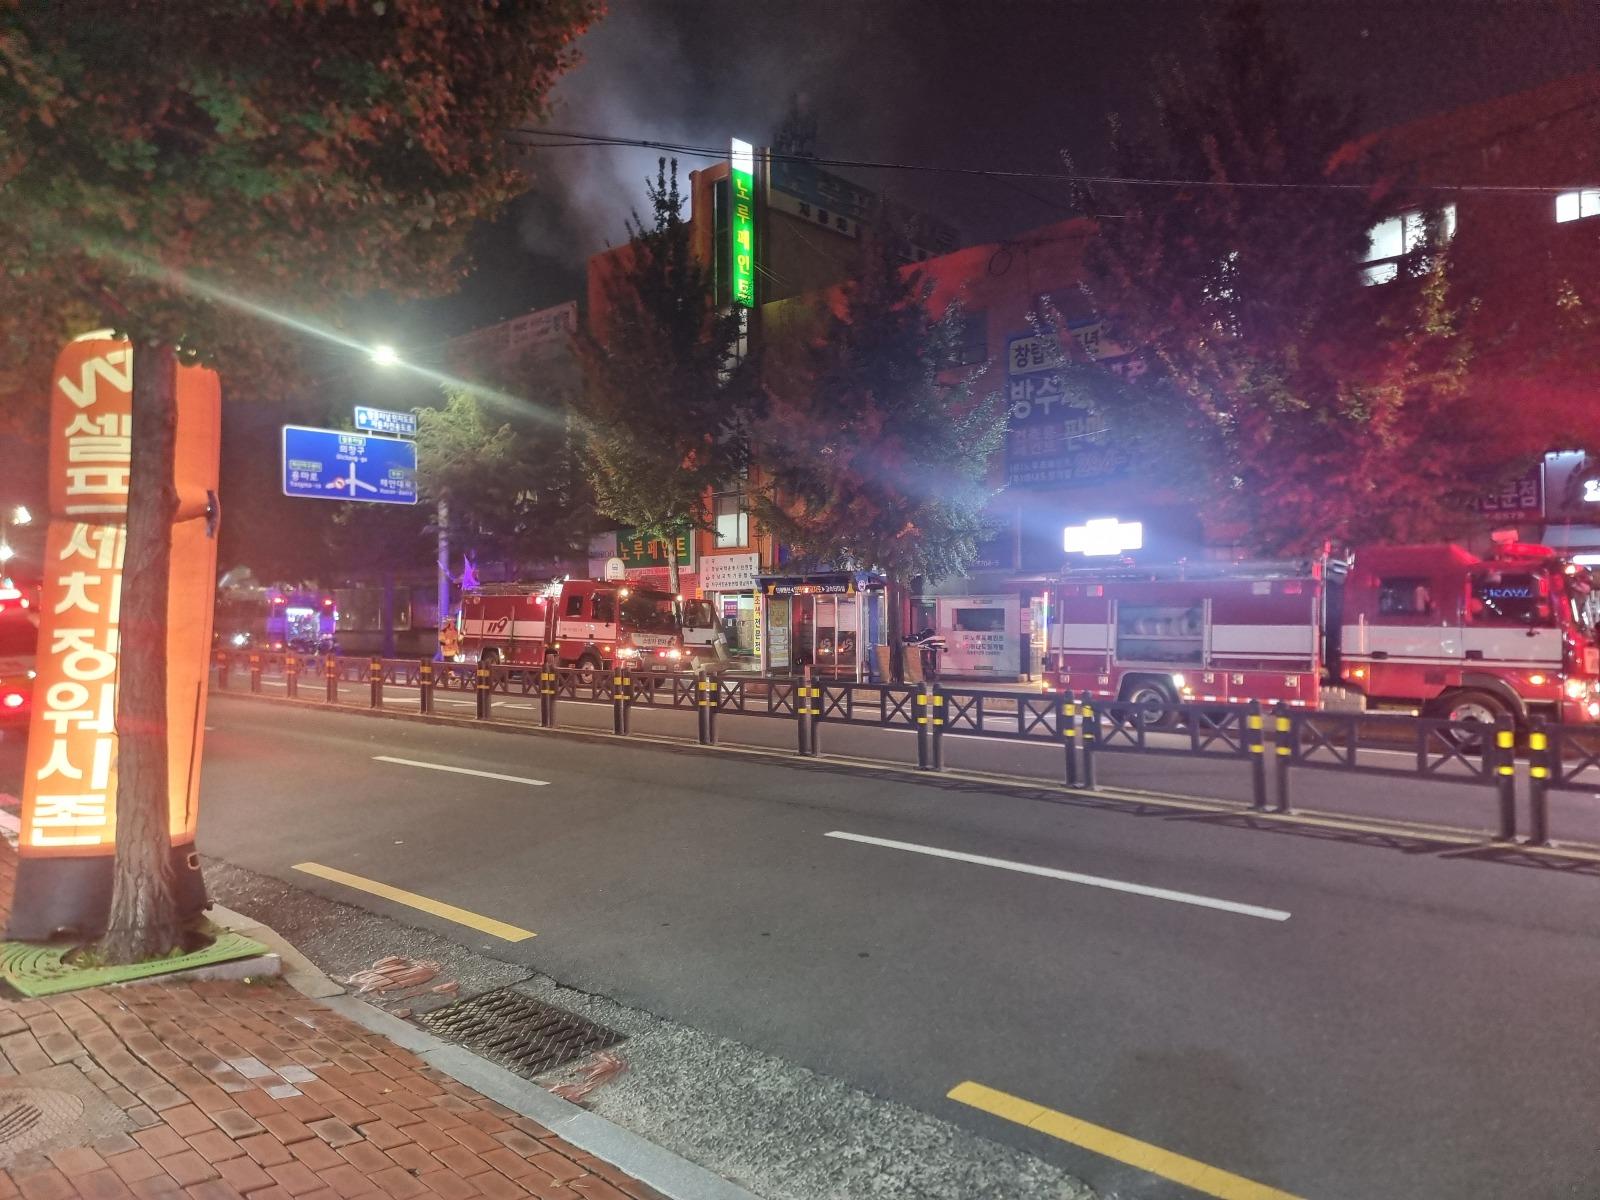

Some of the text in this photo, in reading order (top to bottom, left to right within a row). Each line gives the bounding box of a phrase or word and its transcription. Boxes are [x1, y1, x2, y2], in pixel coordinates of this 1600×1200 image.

[339, 445, 365, 456] 의창구
[291, 471, 319, 482] 용마로
[620, 537, 687, 561] 노루페인트
[487, 618, 507, 632] 119
